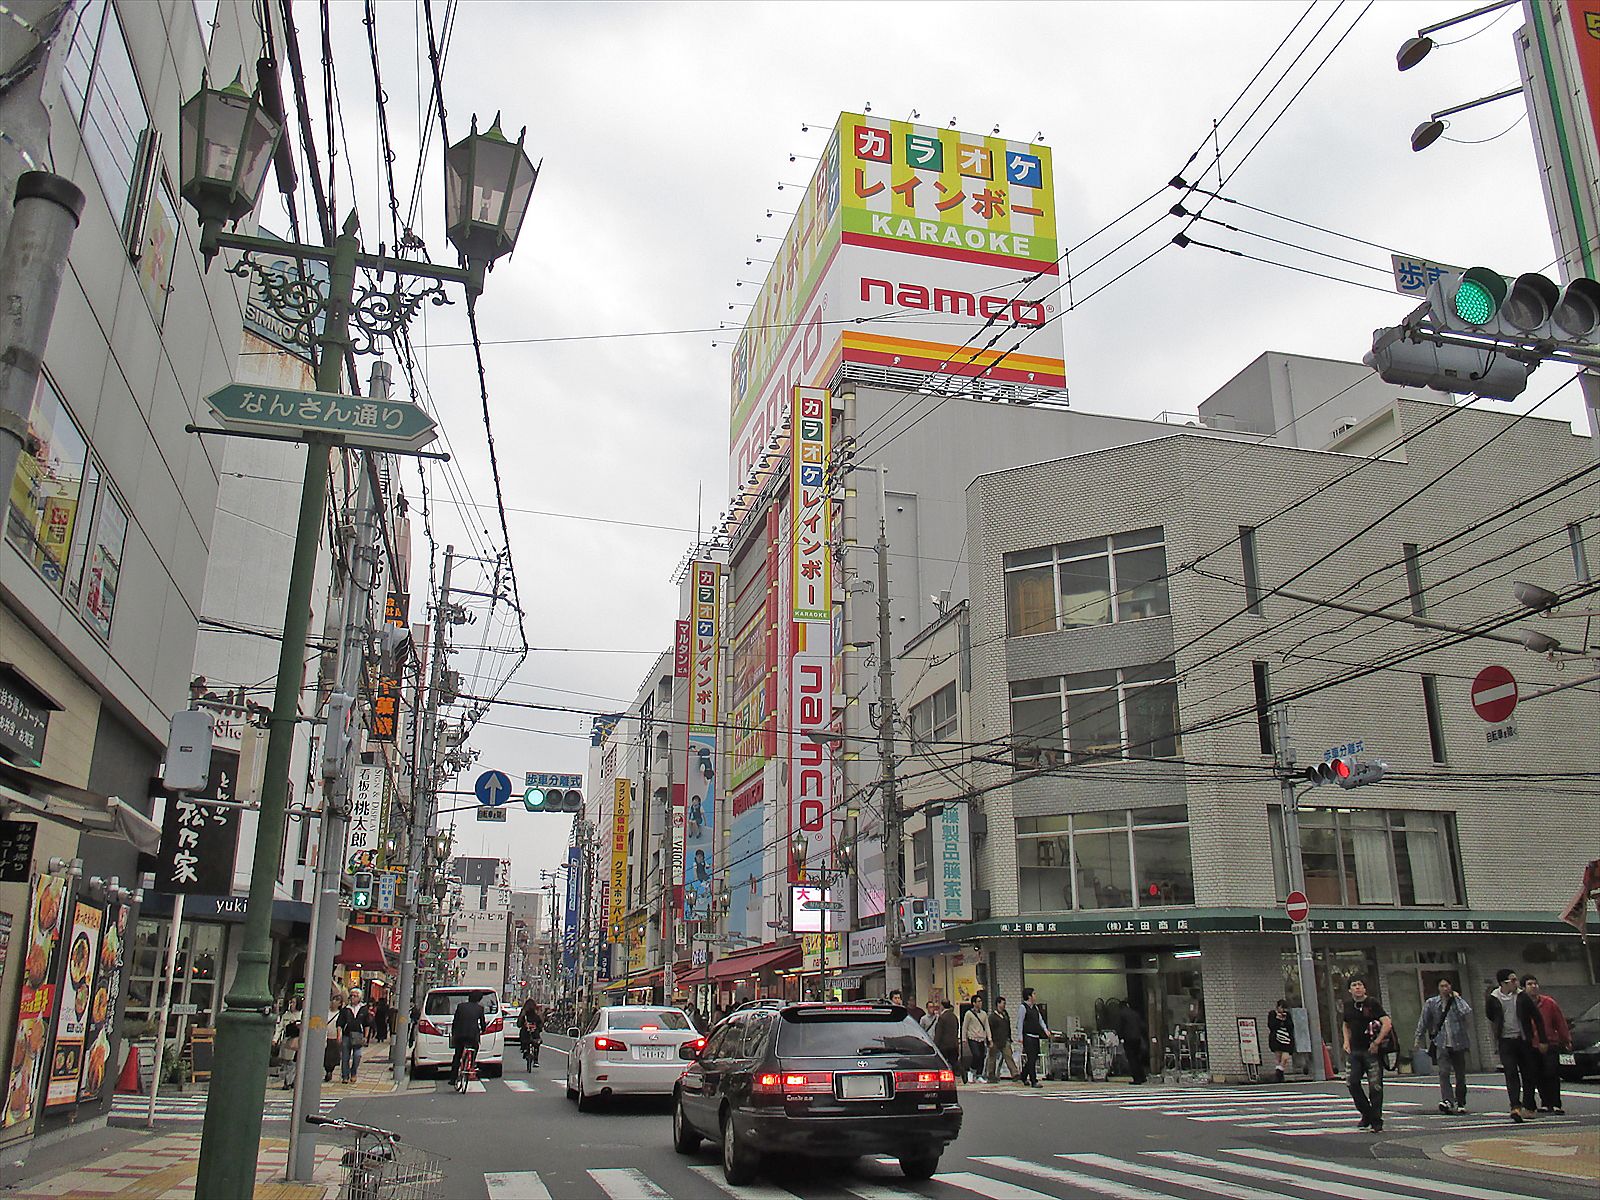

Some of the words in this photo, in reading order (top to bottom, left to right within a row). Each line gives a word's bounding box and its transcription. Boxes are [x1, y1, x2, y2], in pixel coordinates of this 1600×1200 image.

[857, 129, 1037, 180] カラオケ
[854, 167, 1044, 219] レインボー
[871, 213, 1031, 257] KARAOKE
[859, 277, 1046, 327] namco
[239, 391, 405, 430] なんさん通り
[800, 664, 824, 832] namco
[1323, 740, 1364, 762] 歩車分離式
[526, 773, 581, 787] 歩車分離式
[170, 800, 210, 884] 松乃家
[215, 898, 248, 914] yuki
